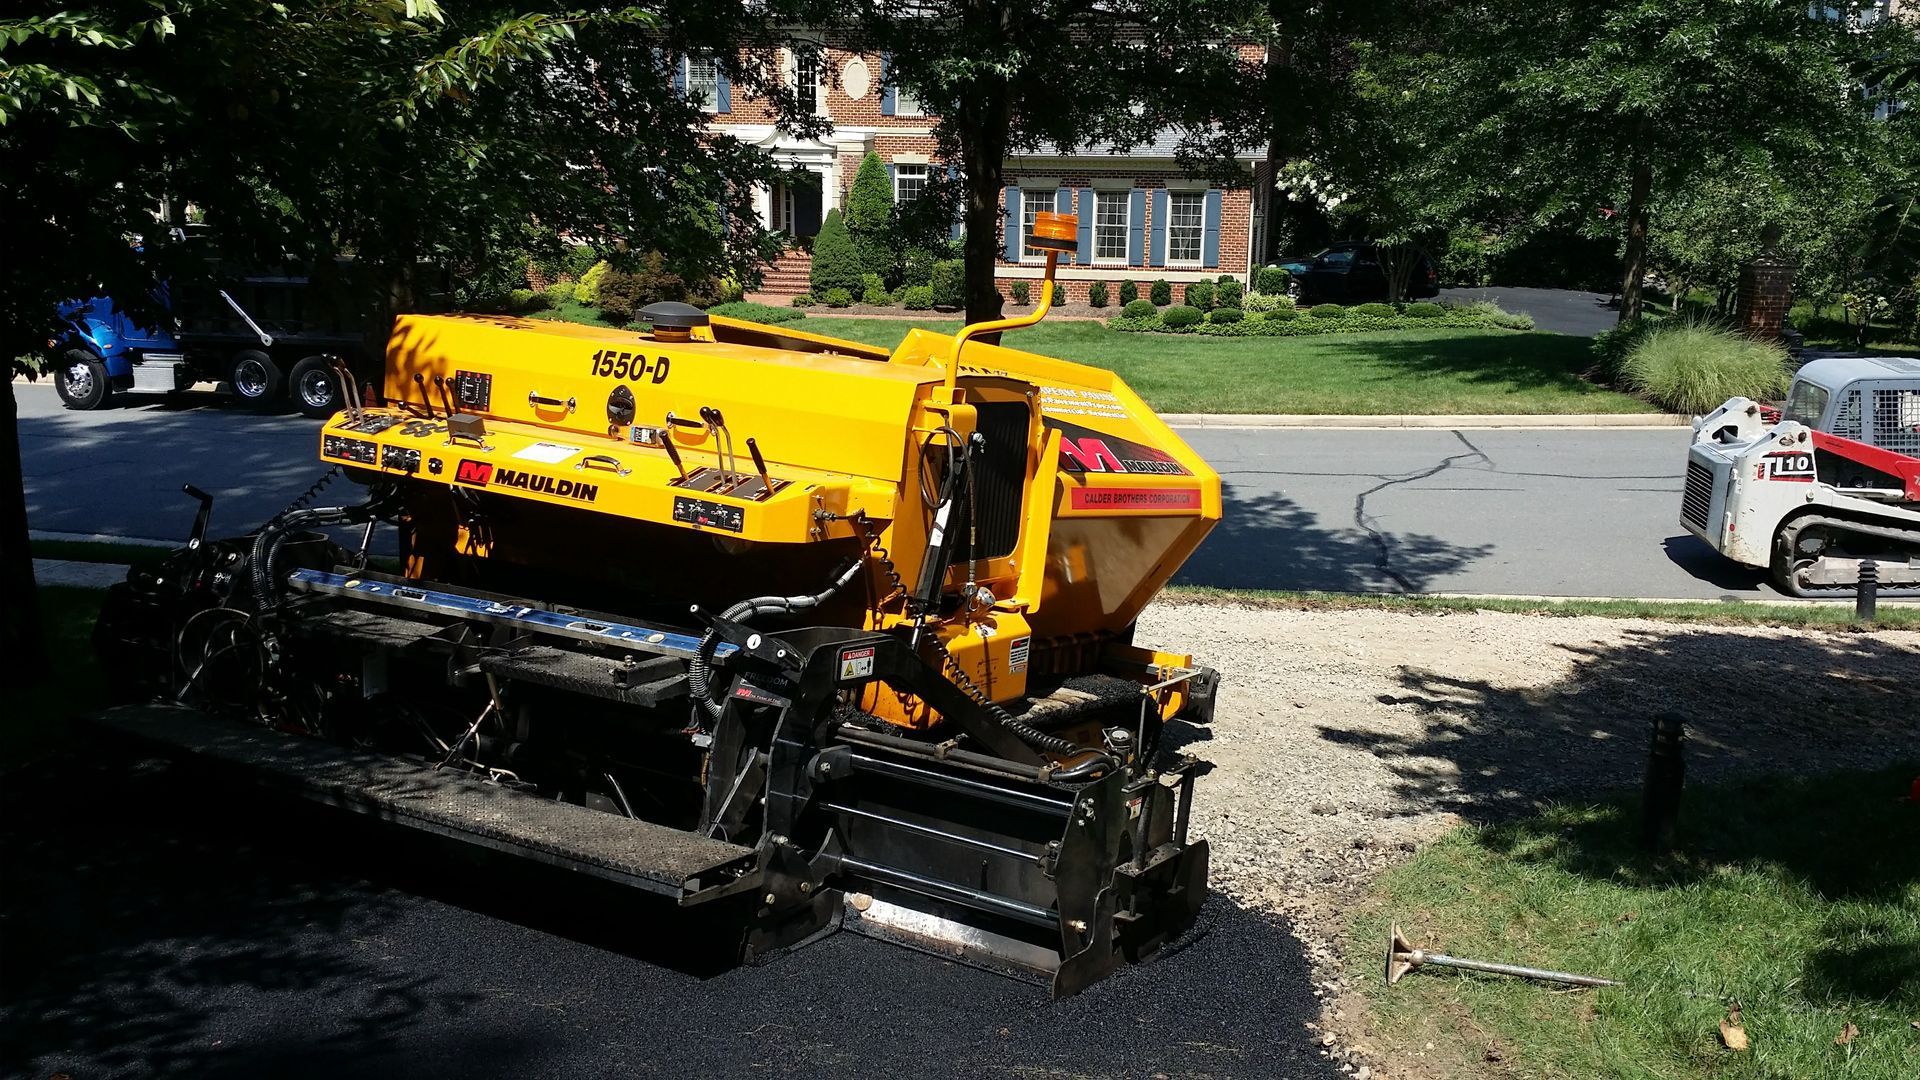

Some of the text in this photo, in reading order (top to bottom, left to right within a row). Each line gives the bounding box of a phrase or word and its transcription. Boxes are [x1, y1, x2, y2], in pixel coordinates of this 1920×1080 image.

[592, 350, 670, 384] 1550-D
[1123, 459, 1184, 475] MAULDIN
[494, 468, 599, 502] MAULDIN
[1084, 493, 1191, 505] CALDER BROTHERS CORPORATION
[852, 650, 871, 659] DANGER
